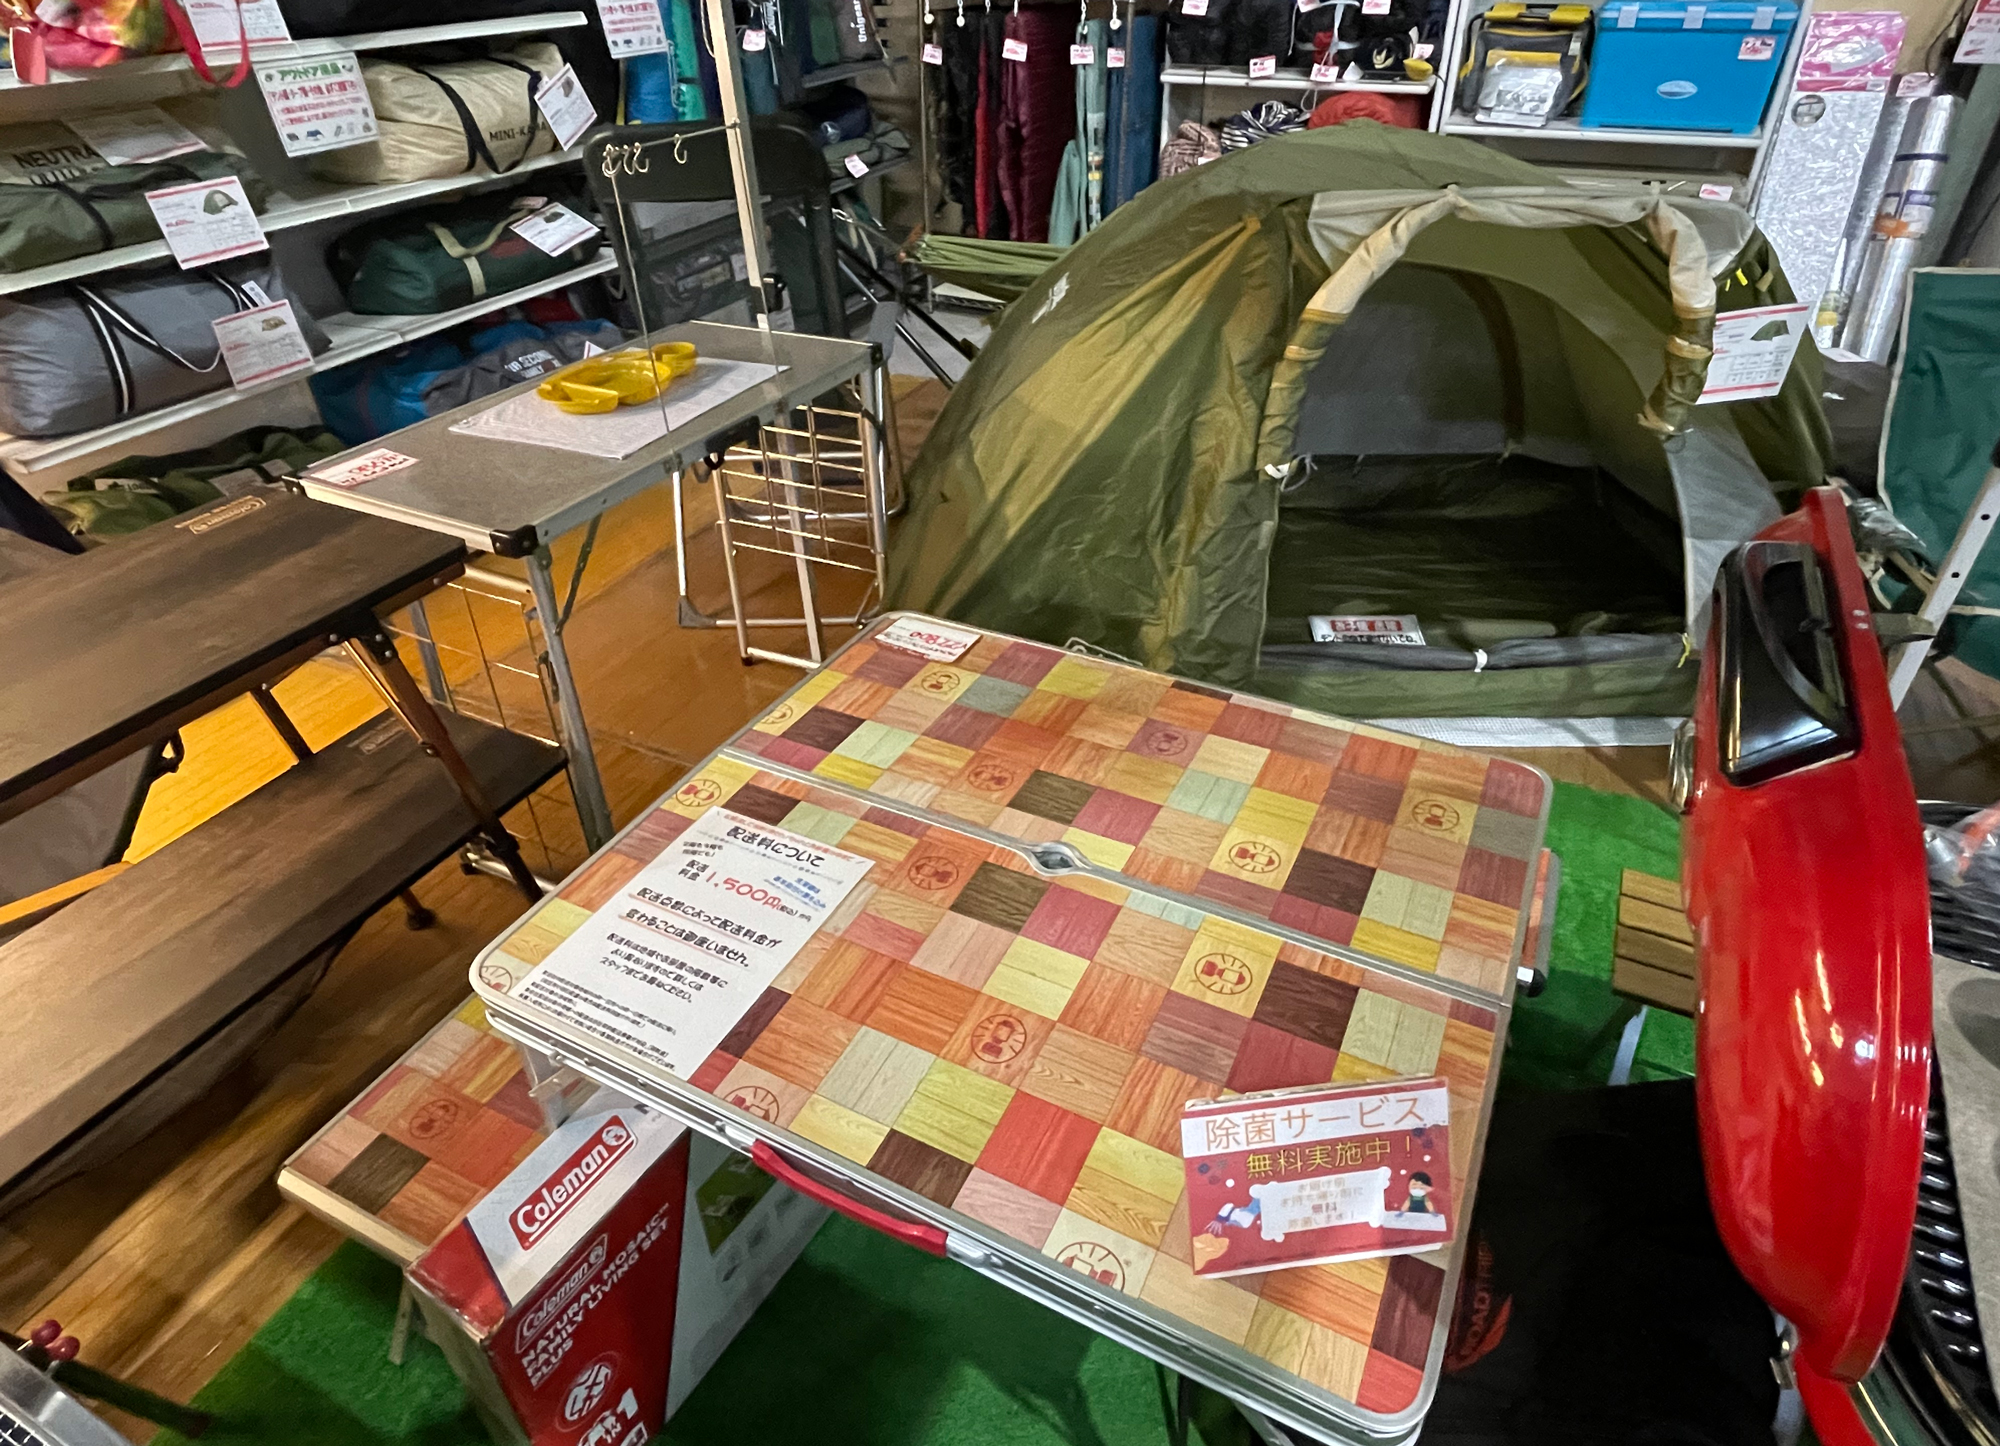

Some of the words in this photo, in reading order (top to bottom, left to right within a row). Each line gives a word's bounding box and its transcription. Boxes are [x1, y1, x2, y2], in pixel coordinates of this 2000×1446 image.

[13, 144, 100, 168] NEUTRA
[726, 824, 825, 868] 配送料について
[1205, 1096, 1425, 1152] 除菌サービス
[516, 1144, 611, 1235] Coleman
[521, 1283, 601, 1366] NATURAL
[522, 1261, 588, 1337] Coleman
[526, 1308, 587, 1378] FAMILY
[588, 1252, 640, 1310] LIVING
[642, 1218, 669, 1254] SET
[531, 1337, 574, 1390] PLUS
